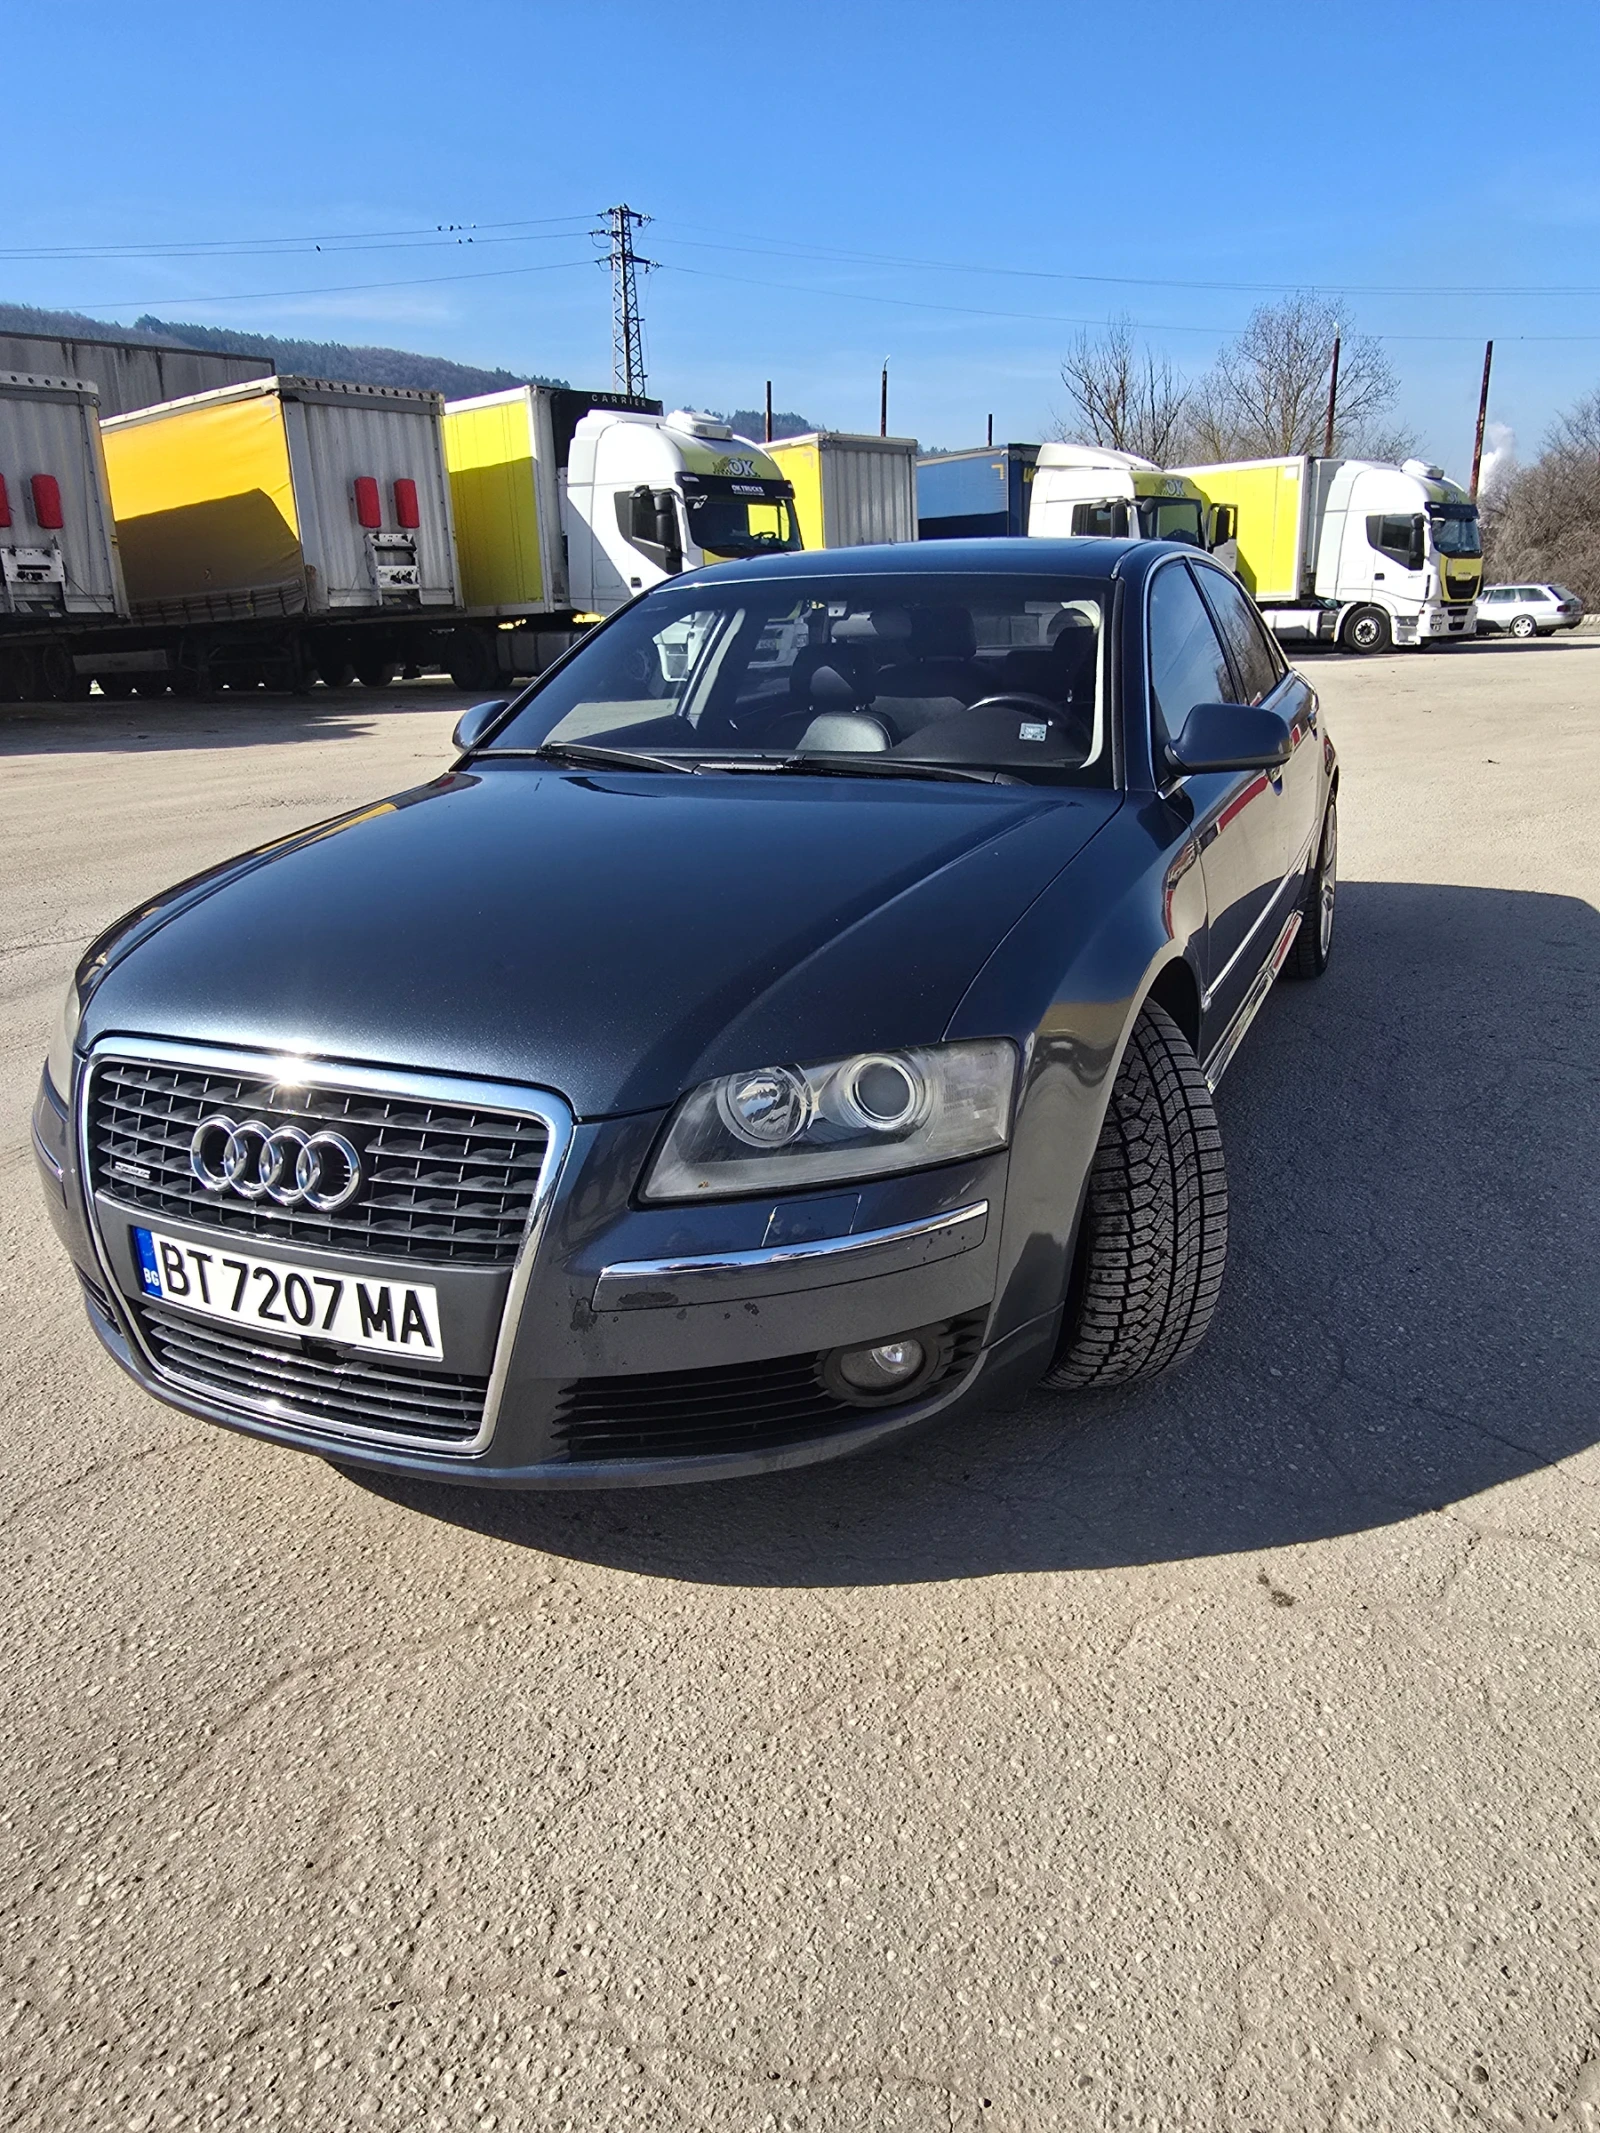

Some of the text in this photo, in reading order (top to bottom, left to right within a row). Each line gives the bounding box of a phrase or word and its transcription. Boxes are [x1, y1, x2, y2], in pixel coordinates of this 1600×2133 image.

[591, 394, 646, 407] CARRIER
[728, 457, 756, 478] OK
[1166, 479, 1185, 496] OK
[143, 1267, 160, 1287] BG
[159, 1241, 435, 1348] BT 7207 MA
